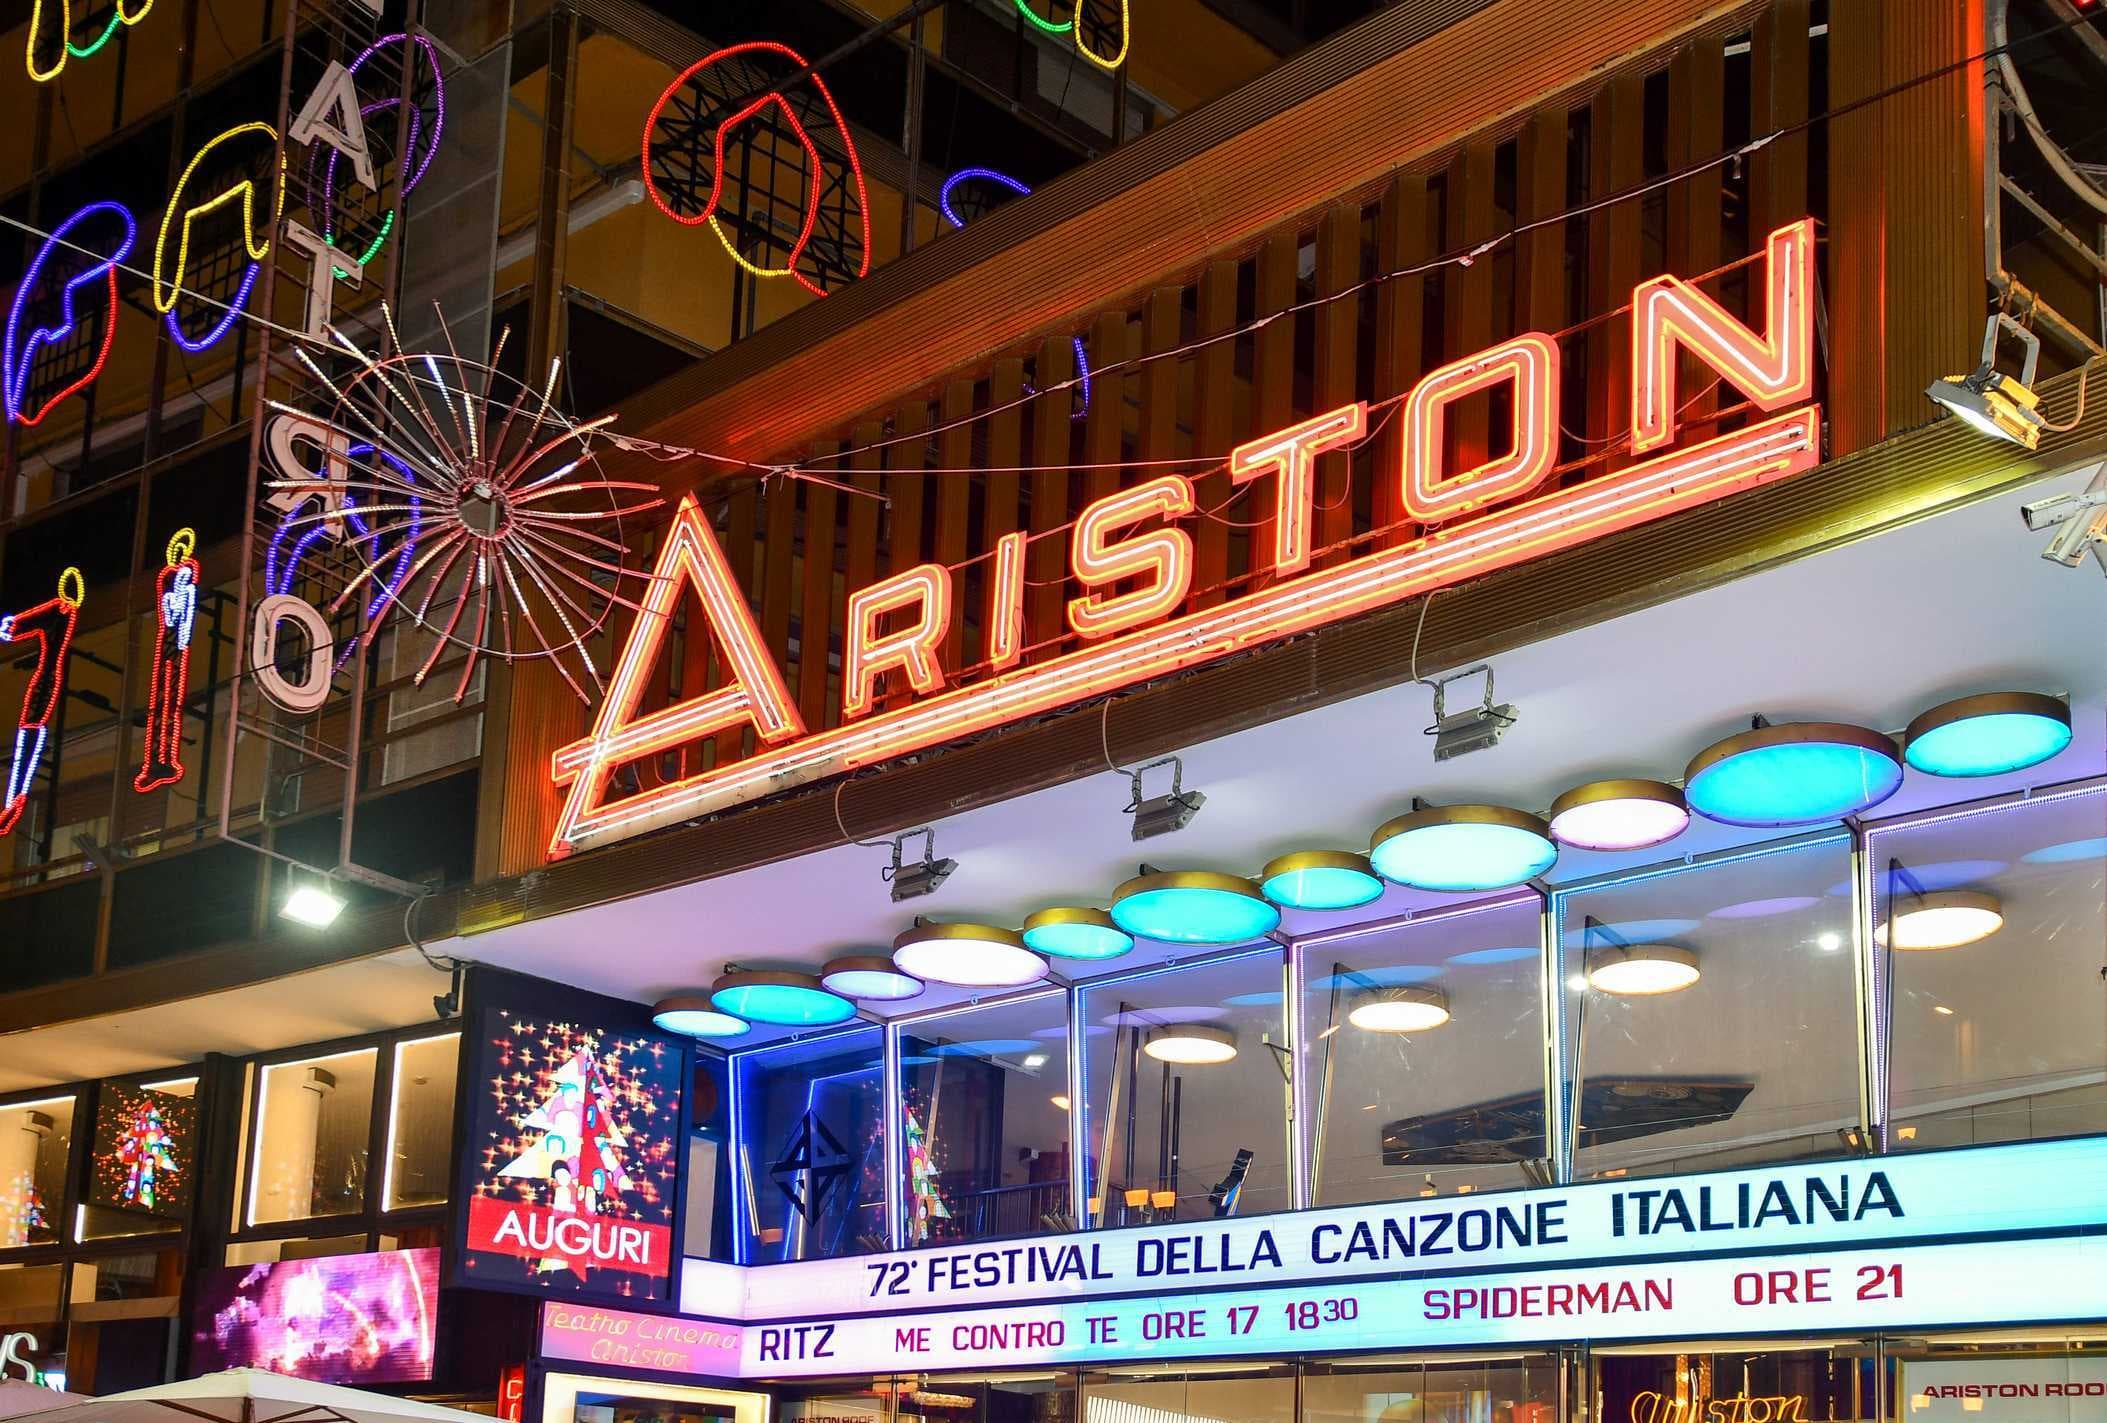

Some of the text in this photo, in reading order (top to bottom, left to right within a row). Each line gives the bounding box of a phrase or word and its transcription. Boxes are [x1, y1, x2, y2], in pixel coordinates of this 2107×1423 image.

[548, 216, 1819, 862] ARISTON
[492, 1210, 651, 1264] AUGURI
[927, 1243, 1114, 1292] FESTIVAL
[1136, 1230, 1283, 1277] DELLA
[1311, 1200, 1569, 1264] CANZONE
[1612, 1171, 1904, 1237] ITALIANA
[637, 1318, 739, 1349] Cinema
[759, 1323, 835, 1362] RITZ
[895, 1328, 931, 1353] ME
[952, 1320, 1065, 1351] CONTRO
[1085, 1316, 1119, 1345] TE
[1143, 1309, 1207, 1341] ORE
[1227, 1305, 1260, 1335] 17
[1423, 1278, 1673, 1321] SPIDERMAN
[1733, 1268, 1832, 1306] ORE
[1856, 1263, 1904, 1301] 21
[1923, 1384, 2038, 1399] ARISTON
